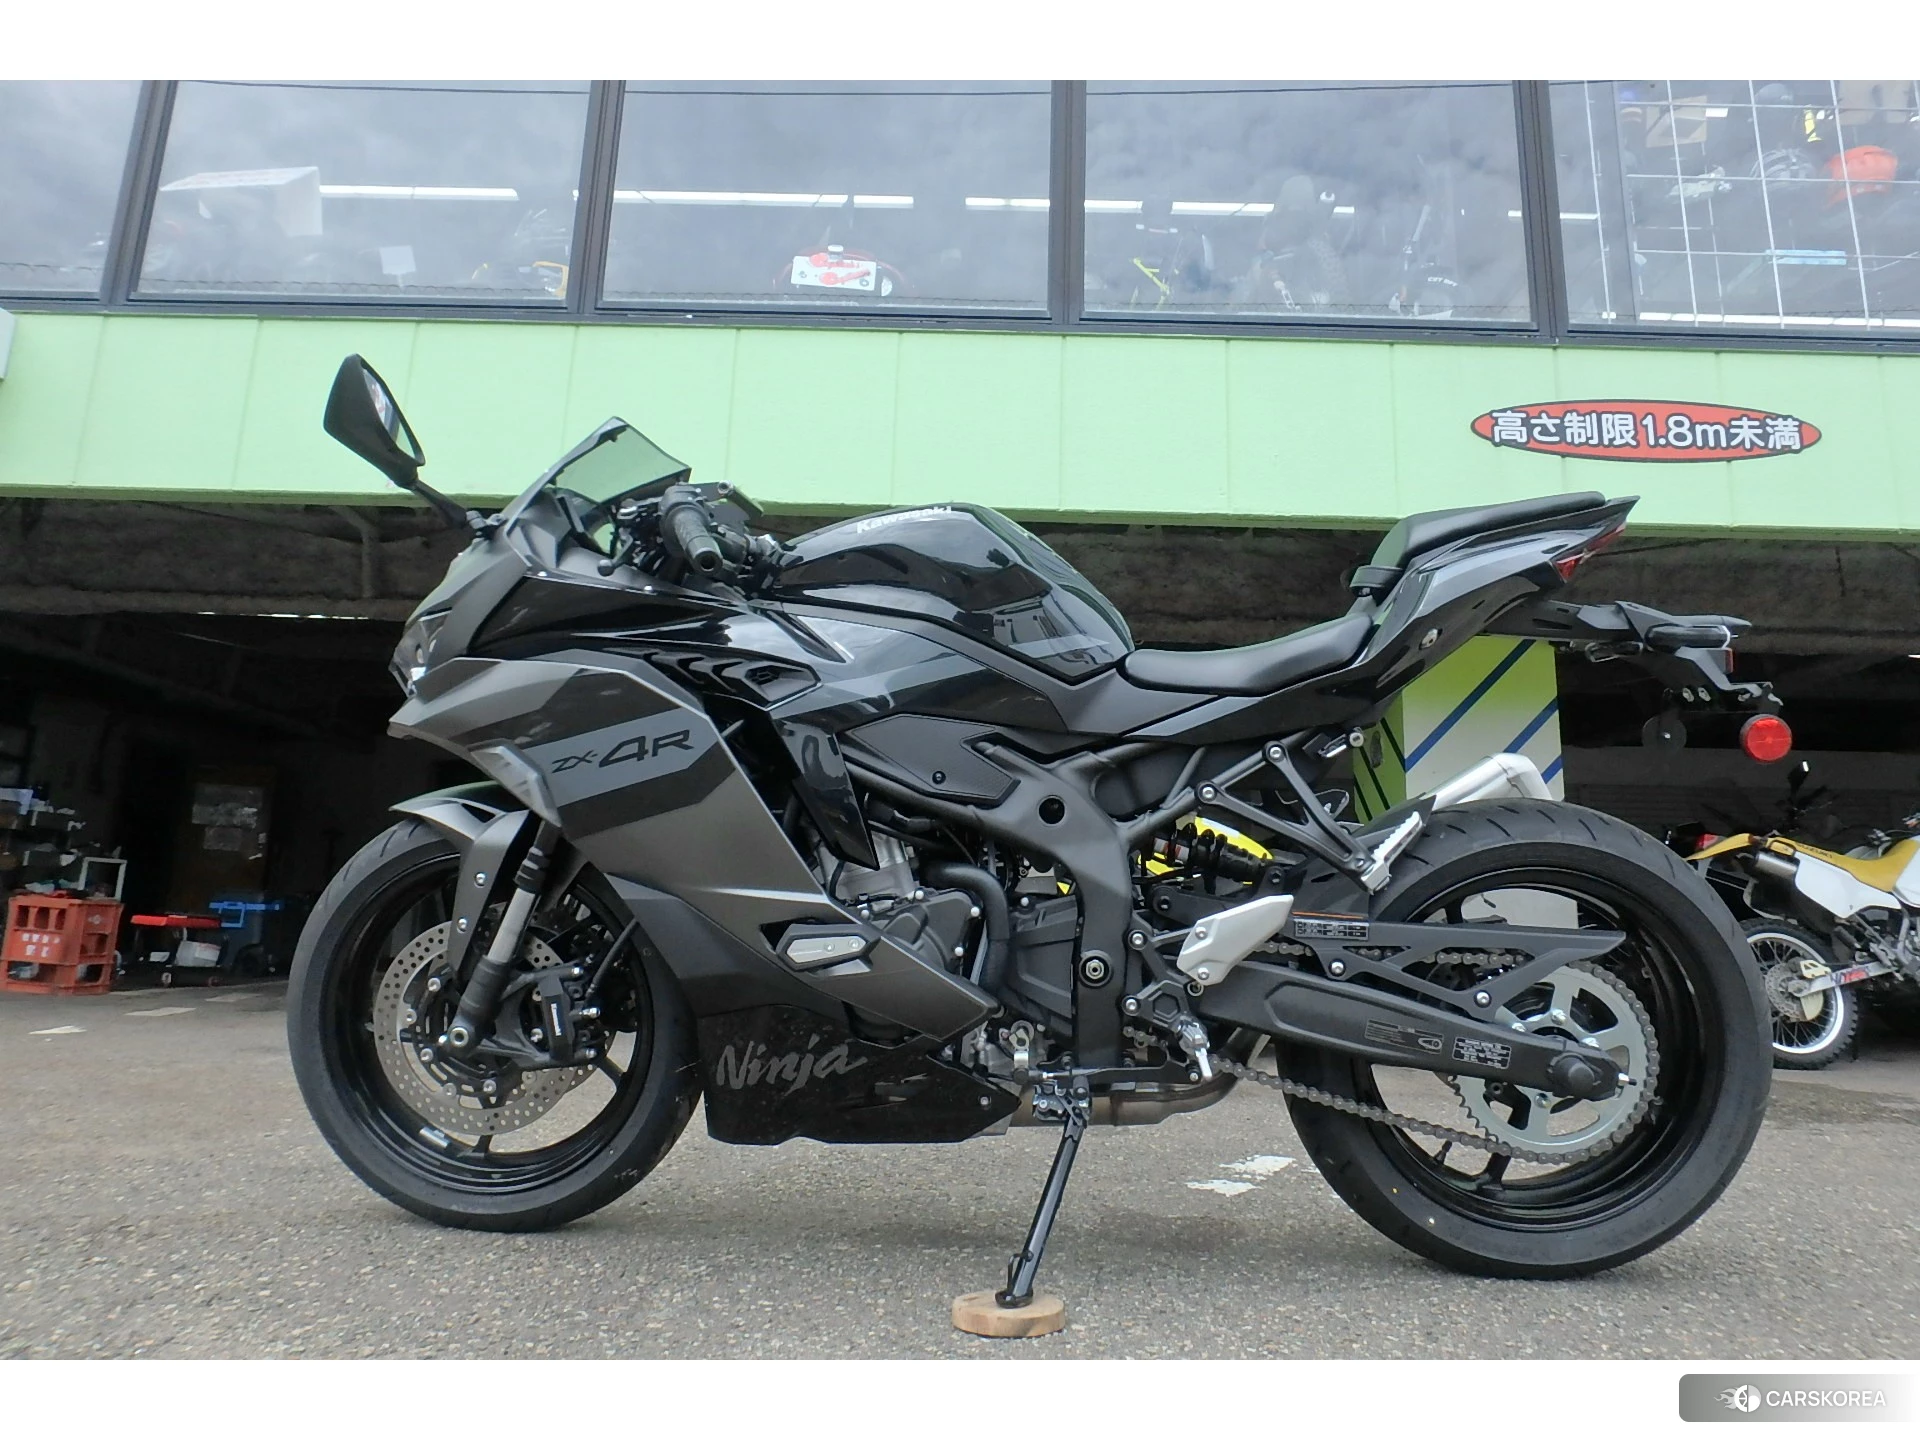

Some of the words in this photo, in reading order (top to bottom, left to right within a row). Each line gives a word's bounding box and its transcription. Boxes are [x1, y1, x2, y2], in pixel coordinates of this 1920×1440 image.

[1493, 411, 1801, 450] 高さ制限1.8m未満
[856, 505, 952, 534] Kawasaki
[551, 729, 695, 774] ZX-4R
[716, 1033, 868, 1097] Ninja
